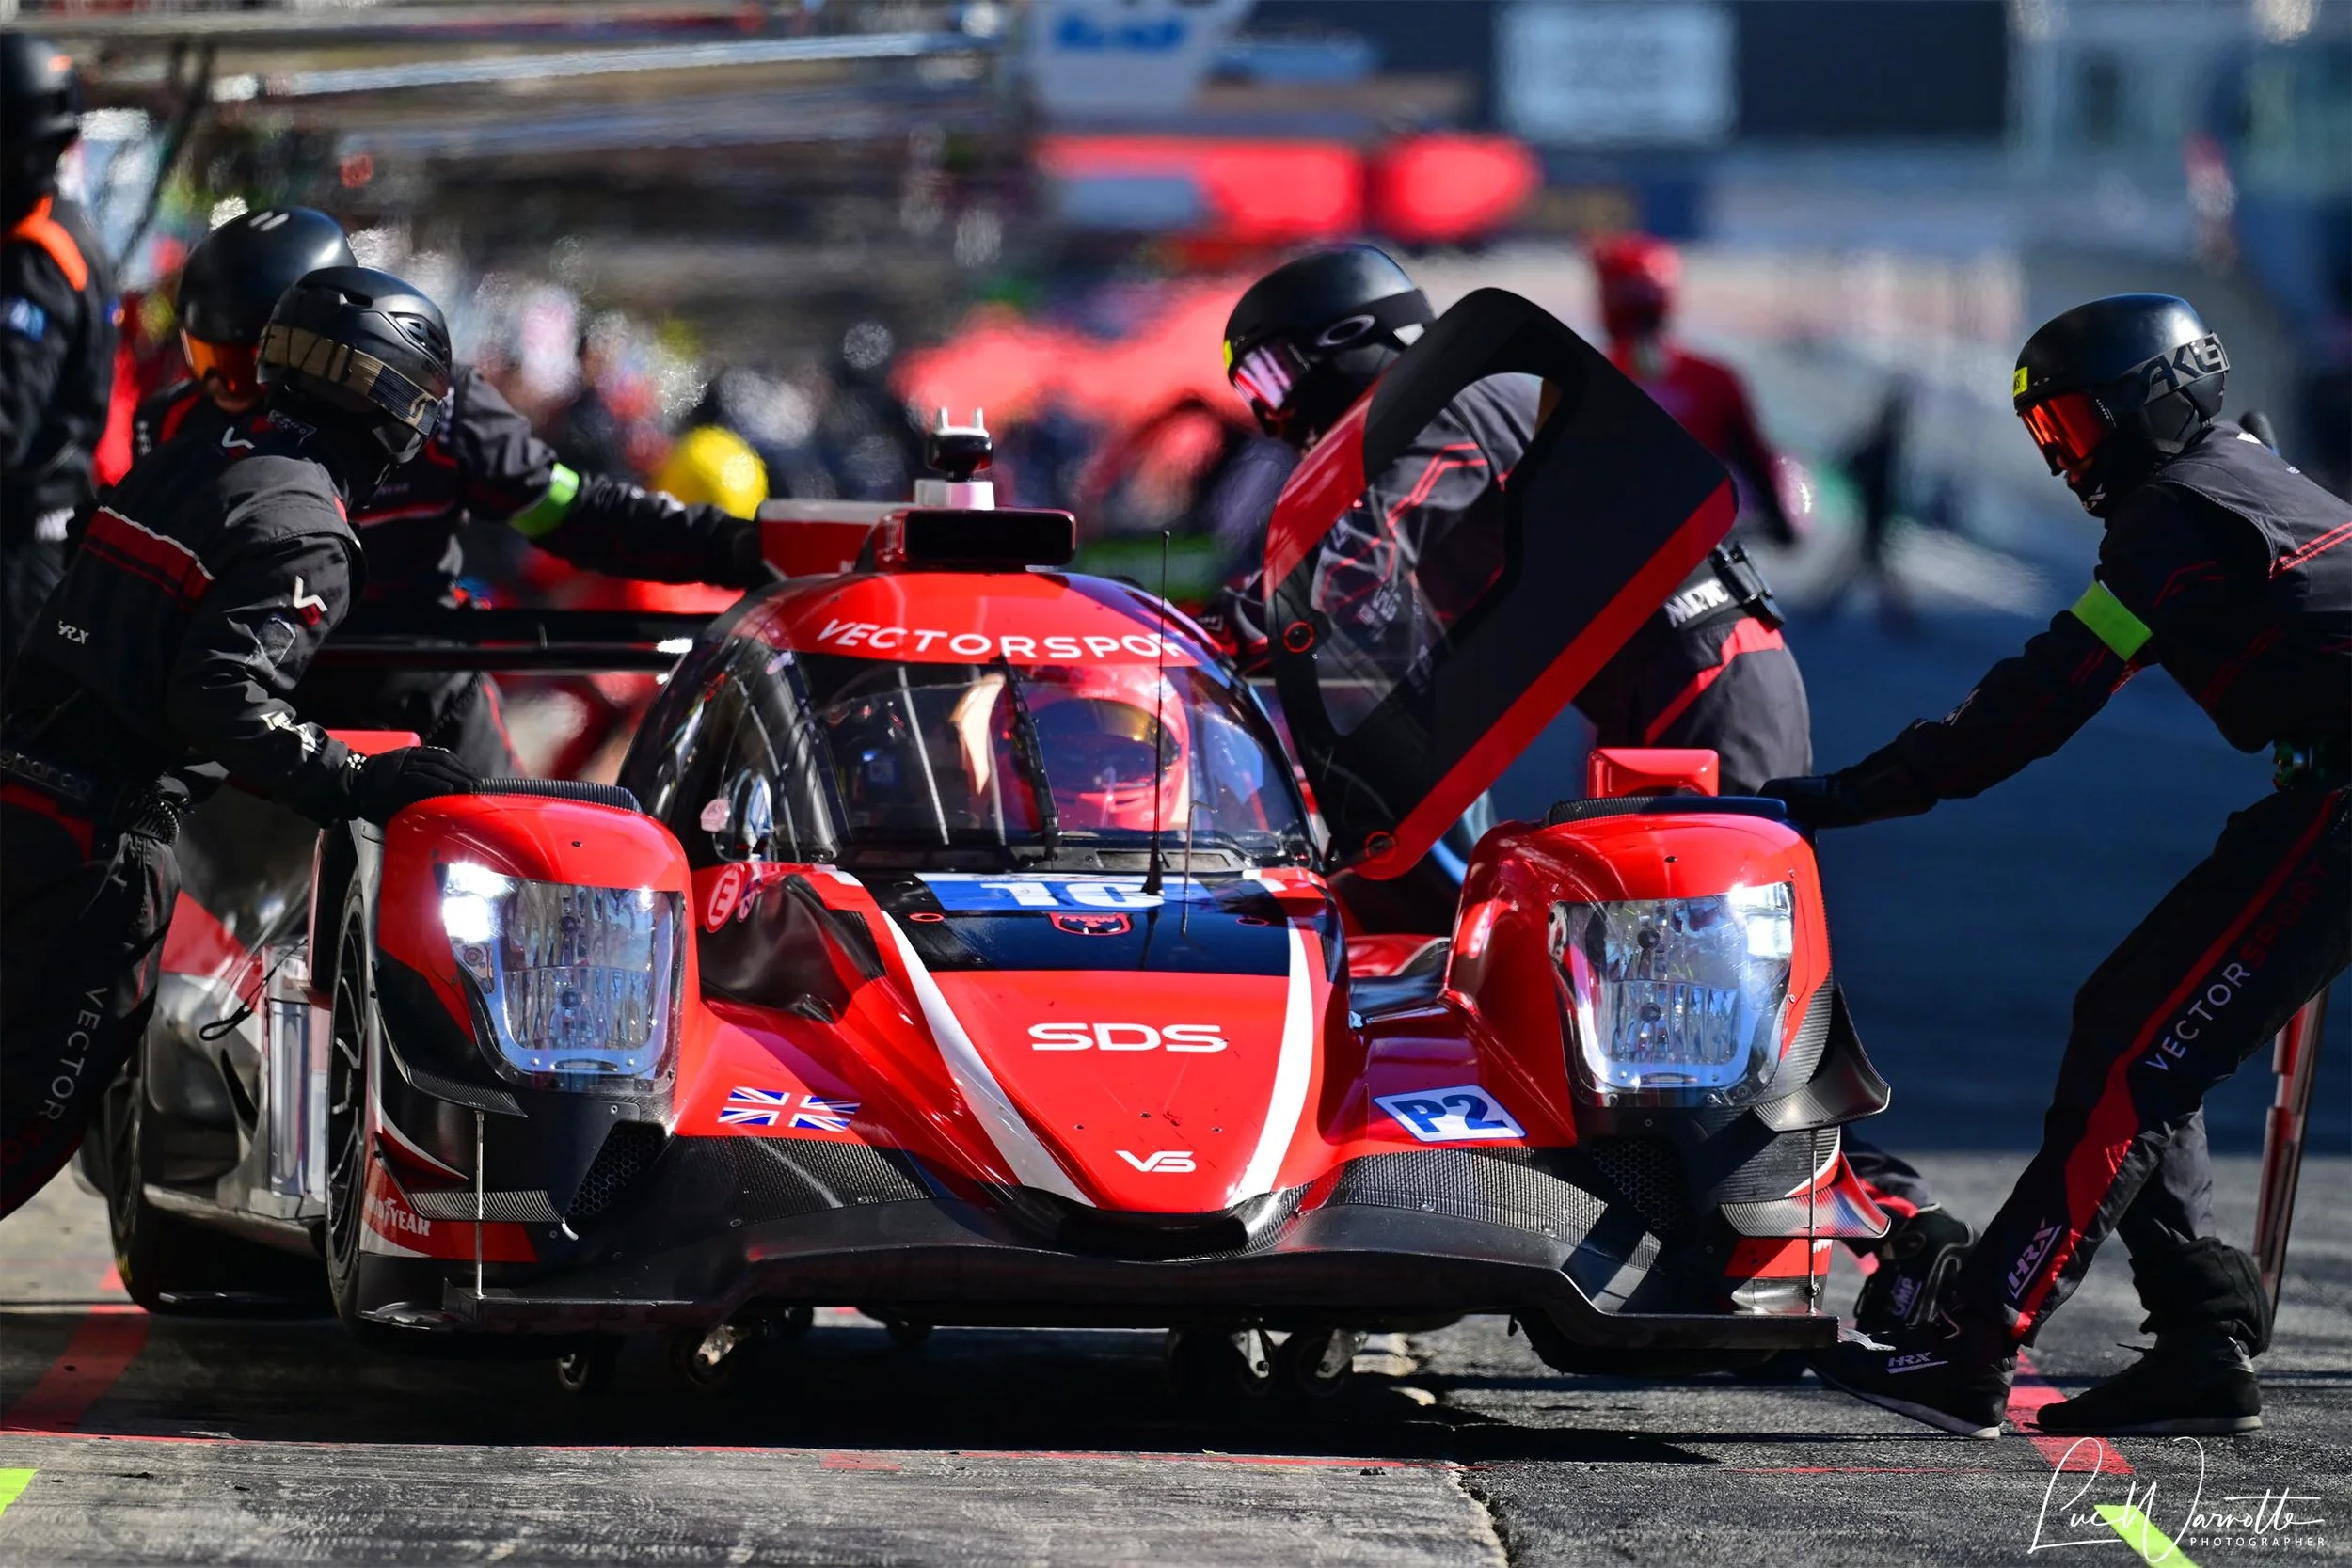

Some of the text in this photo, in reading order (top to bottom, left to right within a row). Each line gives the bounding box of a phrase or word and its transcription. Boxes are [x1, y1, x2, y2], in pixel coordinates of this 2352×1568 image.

[817, 617, 1182, 659] VECTORSPOR
[1028, 1022, 1229, 1053] SDS
[1392, 1094, 1505, 1134] P2
[1115, 1150, 1197, 1173] VS
[2008, 1217, 2058, 1294] HRX
[1888, 1352, 1932, 1368] HRX
